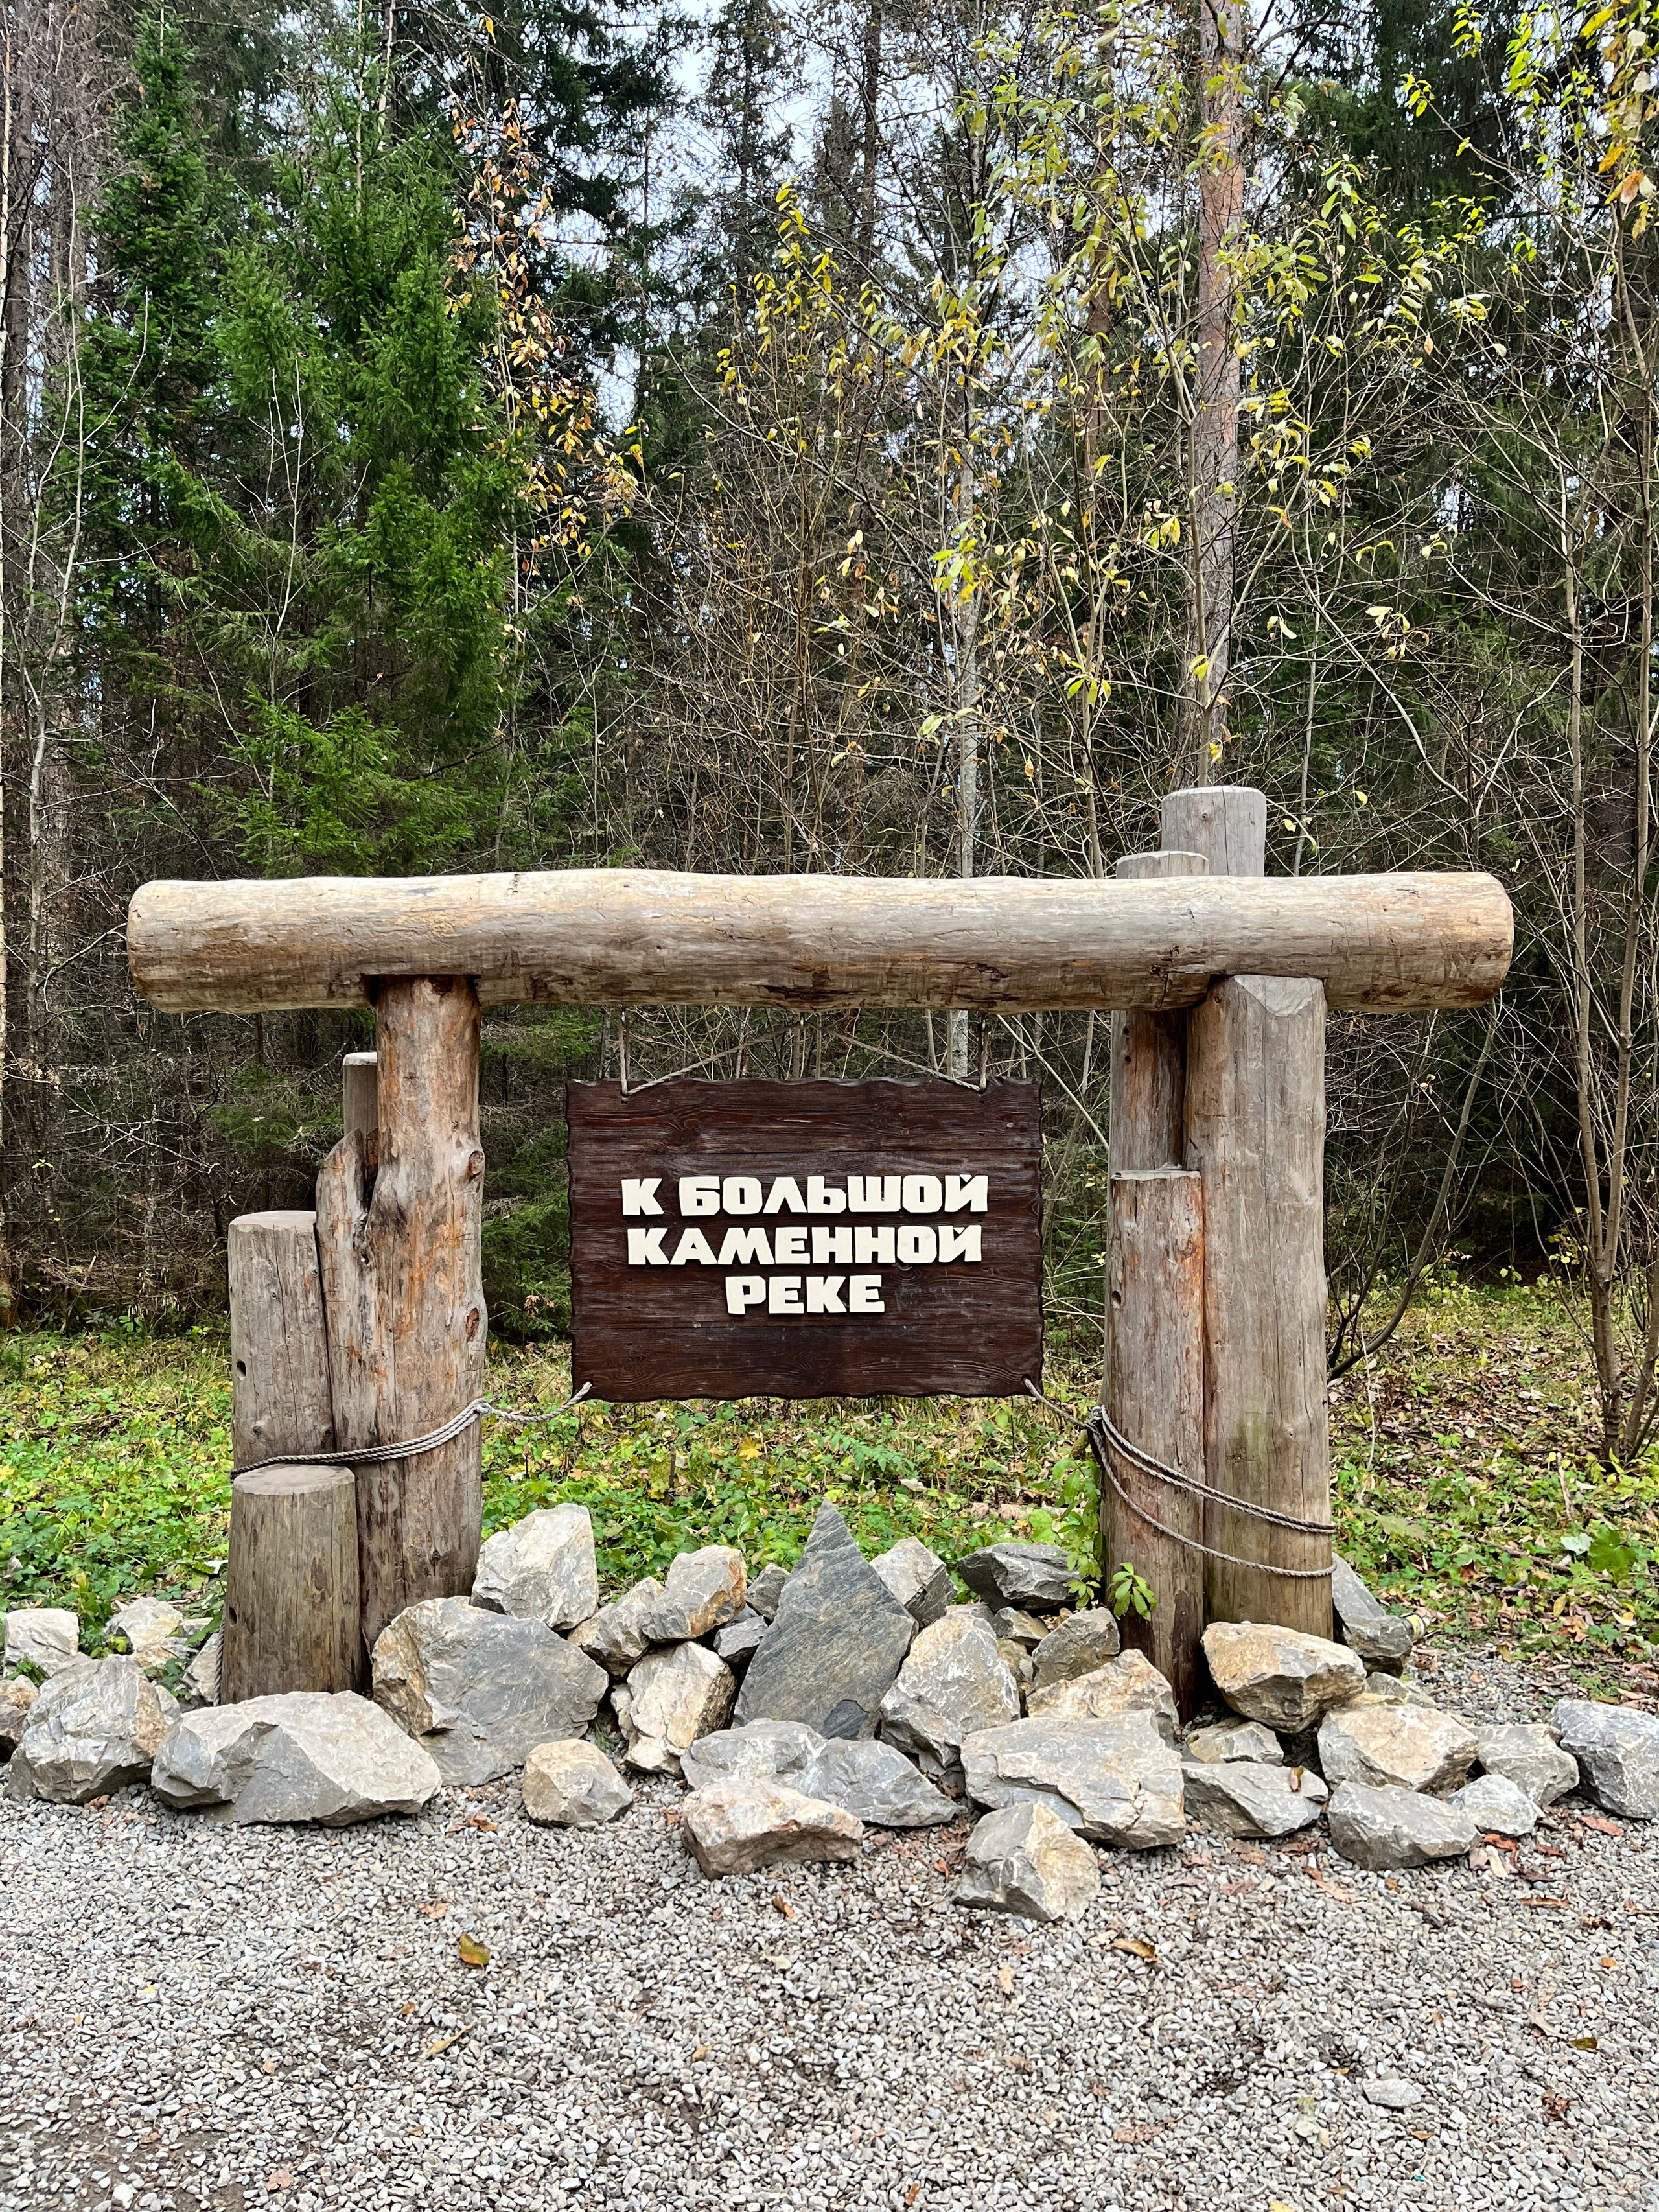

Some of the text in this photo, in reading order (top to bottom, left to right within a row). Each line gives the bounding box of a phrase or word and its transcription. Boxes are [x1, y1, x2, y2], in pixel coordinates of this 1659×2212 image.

[620, 1174, 989, 1217] К БОЛЬШОЙ
[627, 1224, 982, 1266] КАМЕННОЙ
[725, 1274, 886, 1316] РЕКЕ
